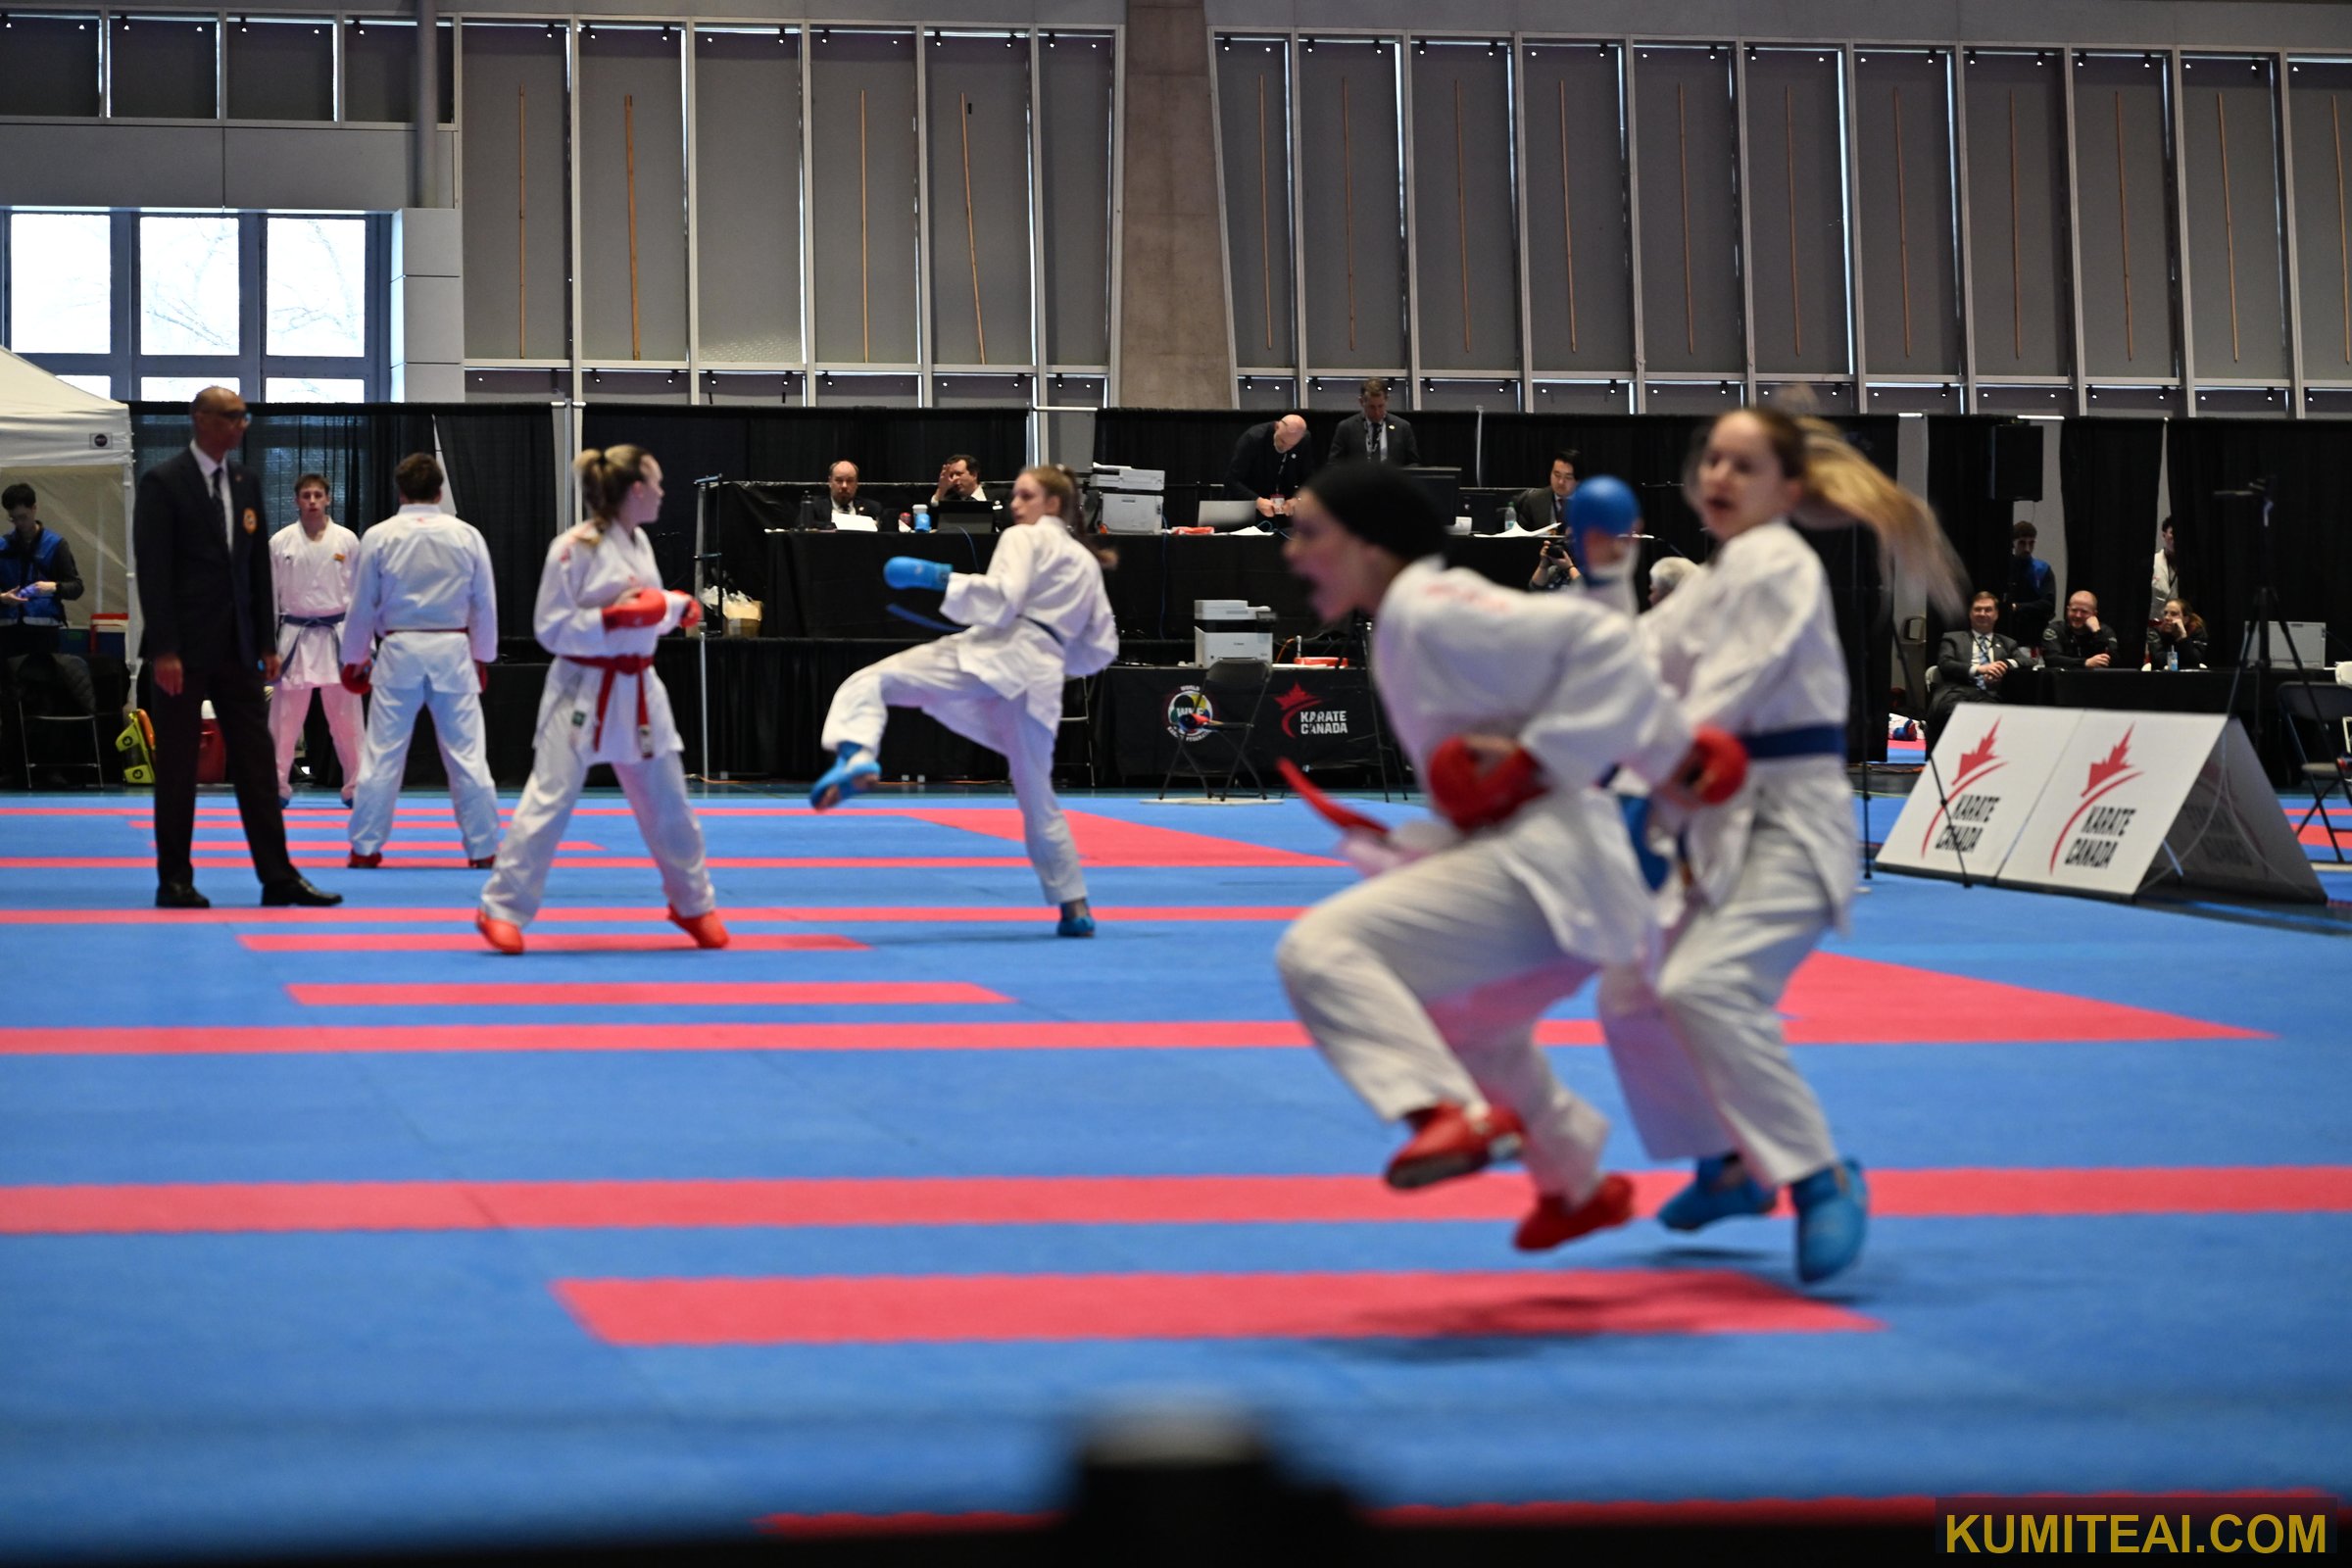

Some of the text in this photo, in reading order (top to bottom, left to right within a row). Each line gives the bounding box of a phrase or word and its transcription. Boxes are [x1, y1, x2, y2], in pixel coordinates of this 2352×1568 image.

[1300, 710, 1348, 722] KARATE
[1952, 795, 2000, 823] KARATE
[2081, 806, 2136, 836] KARATE
[1936, 825, 1983, 854] CANADA
[2065, 838, 2119, 869] CANADA
